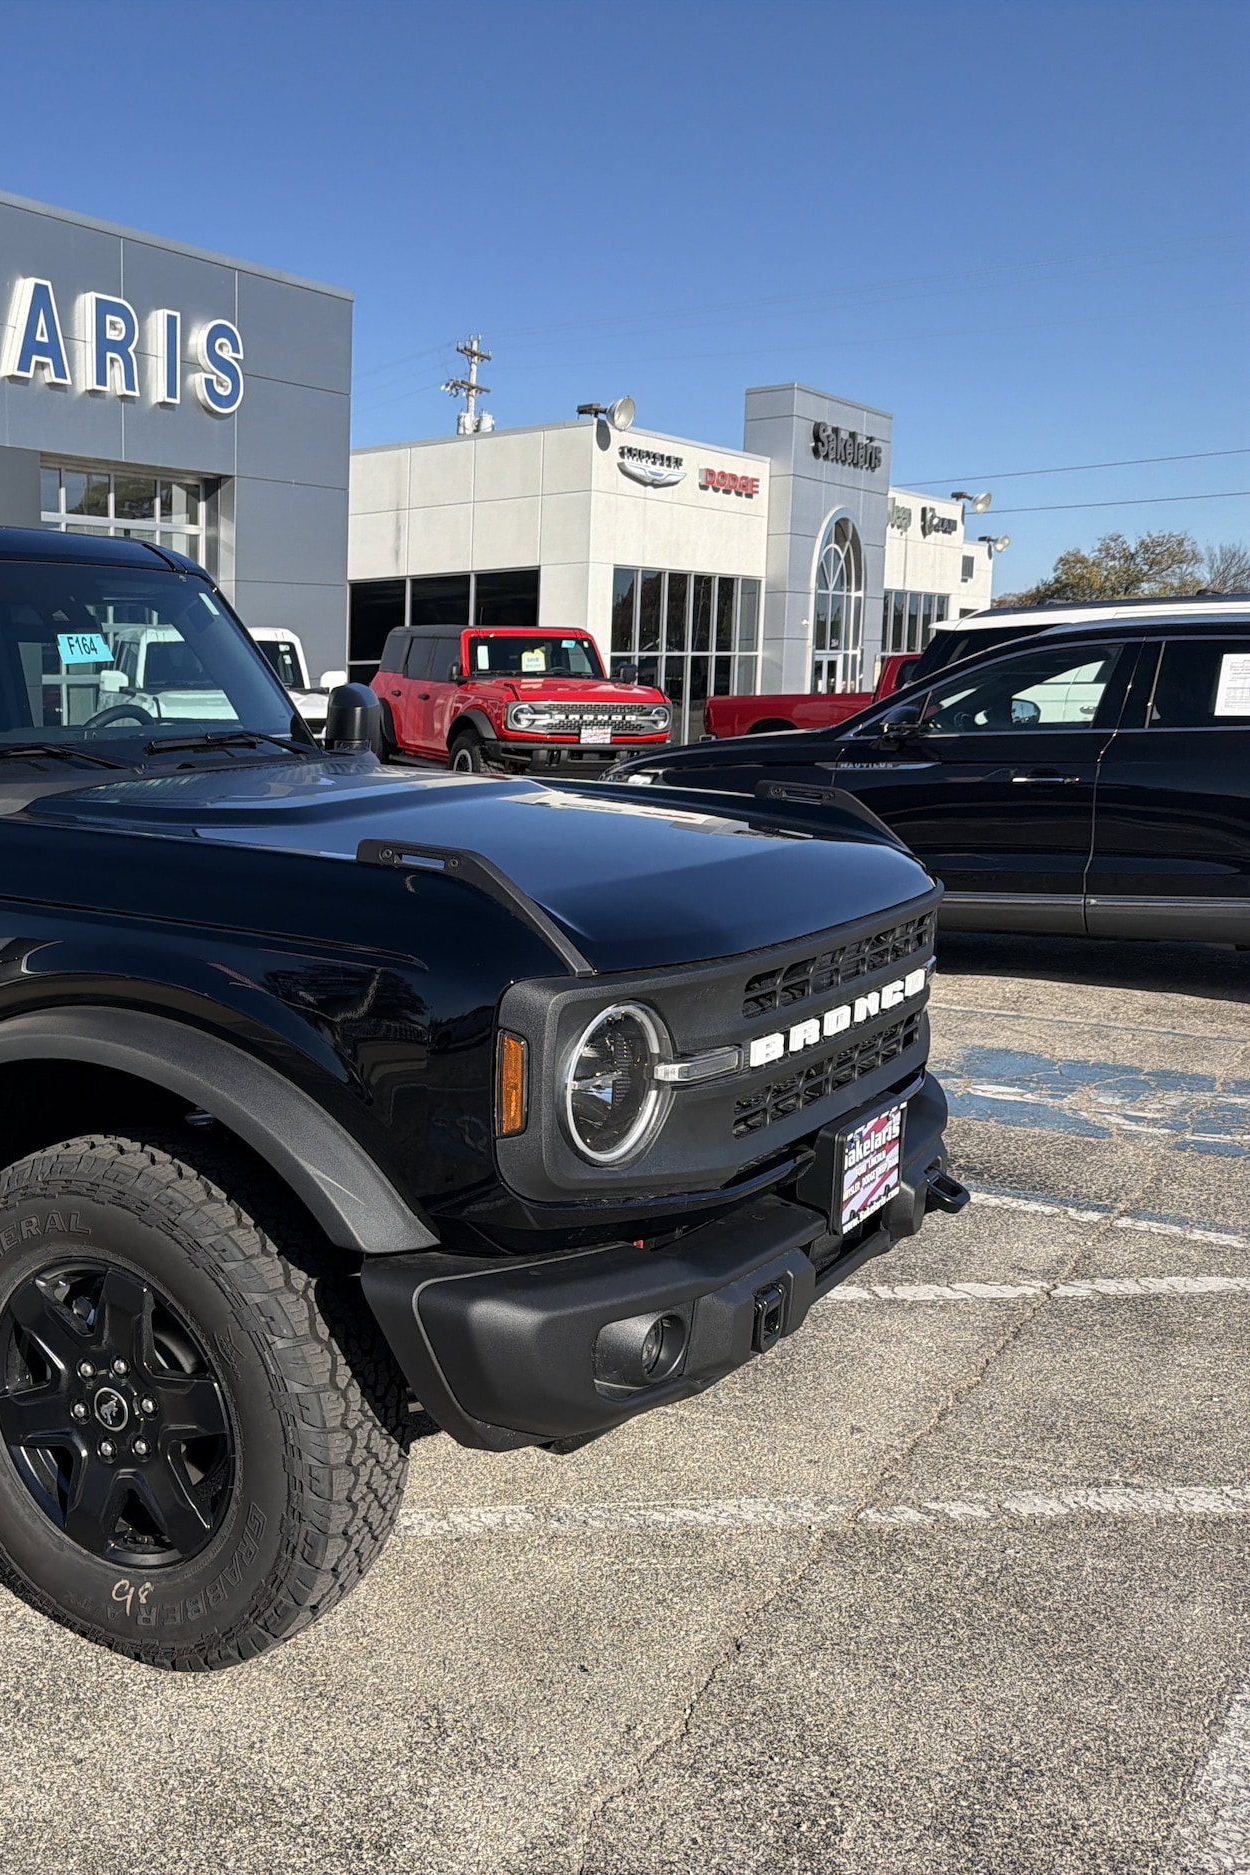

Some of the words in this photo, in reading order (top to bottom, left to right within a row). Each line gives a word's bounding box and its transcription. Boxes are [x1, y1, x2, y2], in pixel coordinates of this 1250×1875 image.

[813, 421, 882, 472] Sakelaris
[701, 468, 760, 495] DODGE
[67, 636, 99, 656] F164
[749, 968, 926, 1068] BRONCO
[135, 1501, 267, 1627] GRABBER
